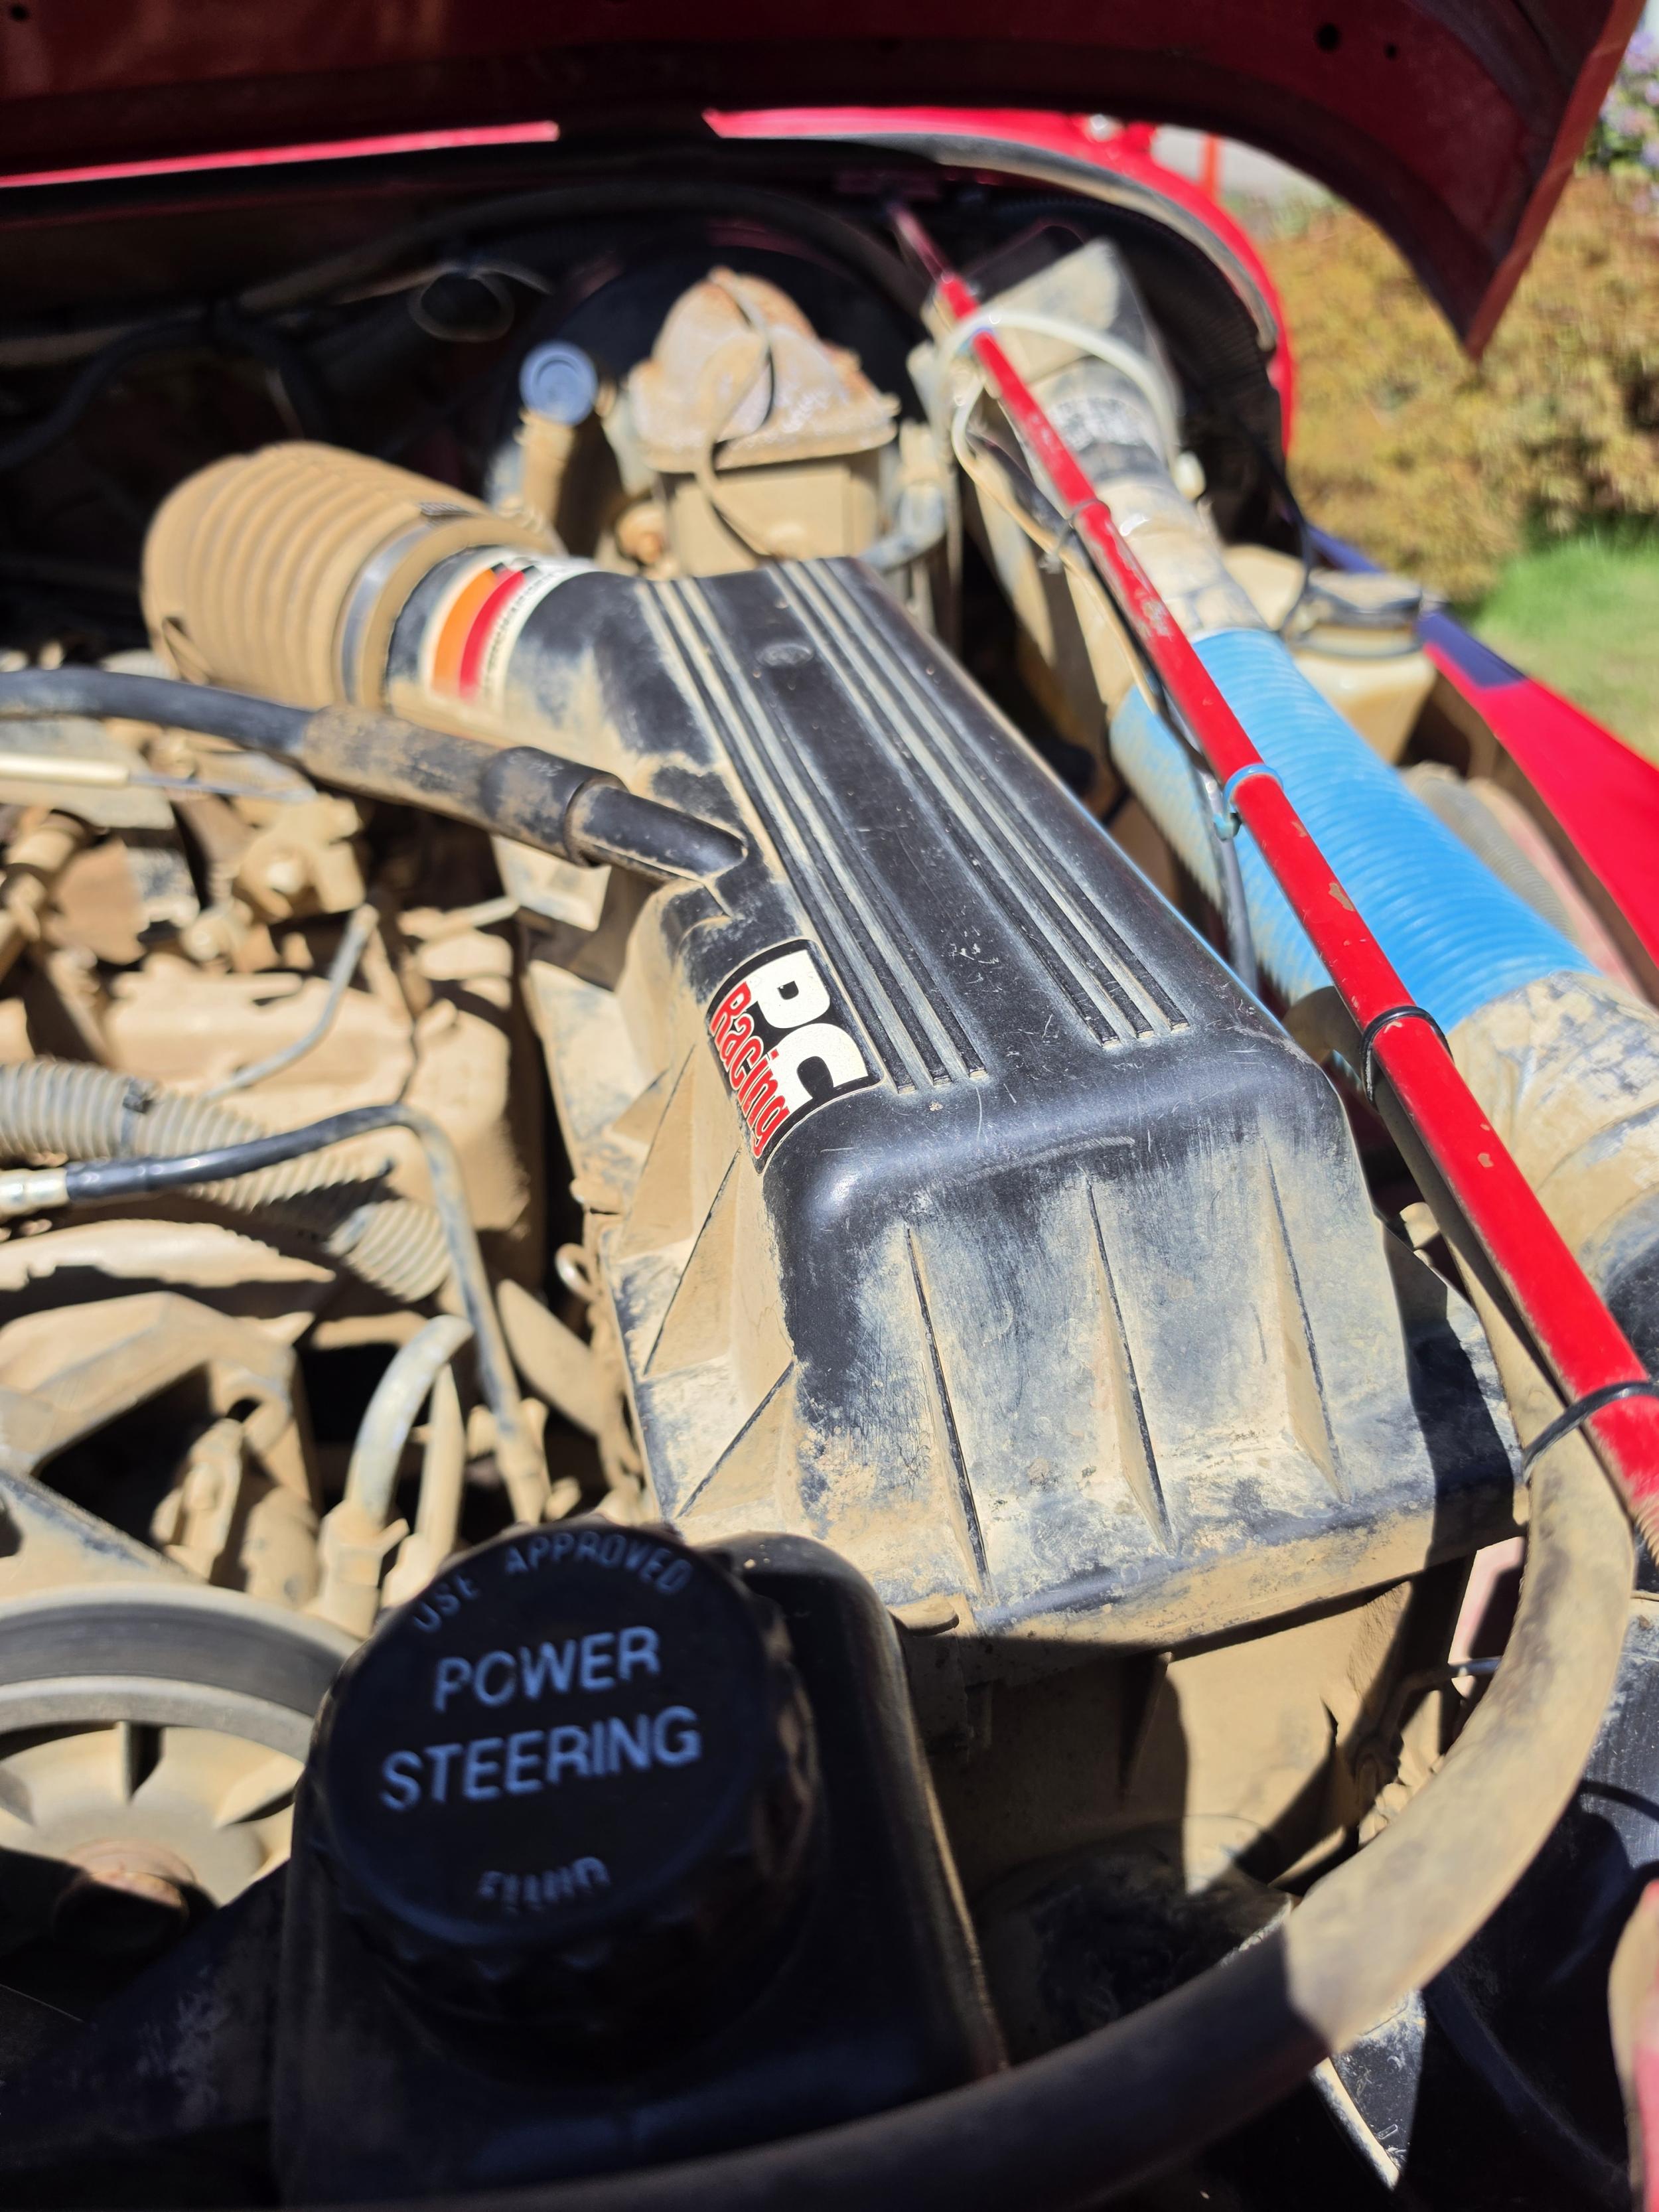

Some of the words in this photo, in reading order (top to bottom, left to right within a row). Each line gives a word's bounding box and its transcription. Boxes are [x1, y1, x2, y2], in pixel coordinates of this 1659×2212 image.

[710, 981, 790, 1158] Racing
[746, 950, 868, 1115] PC
[412, 1576, 480, 1633] USE
[505, 1531, 693, 1595] APPROVED
[433, 1625, 661, 1712] POWER
[380, 1705, 703, 1810] STEERING
